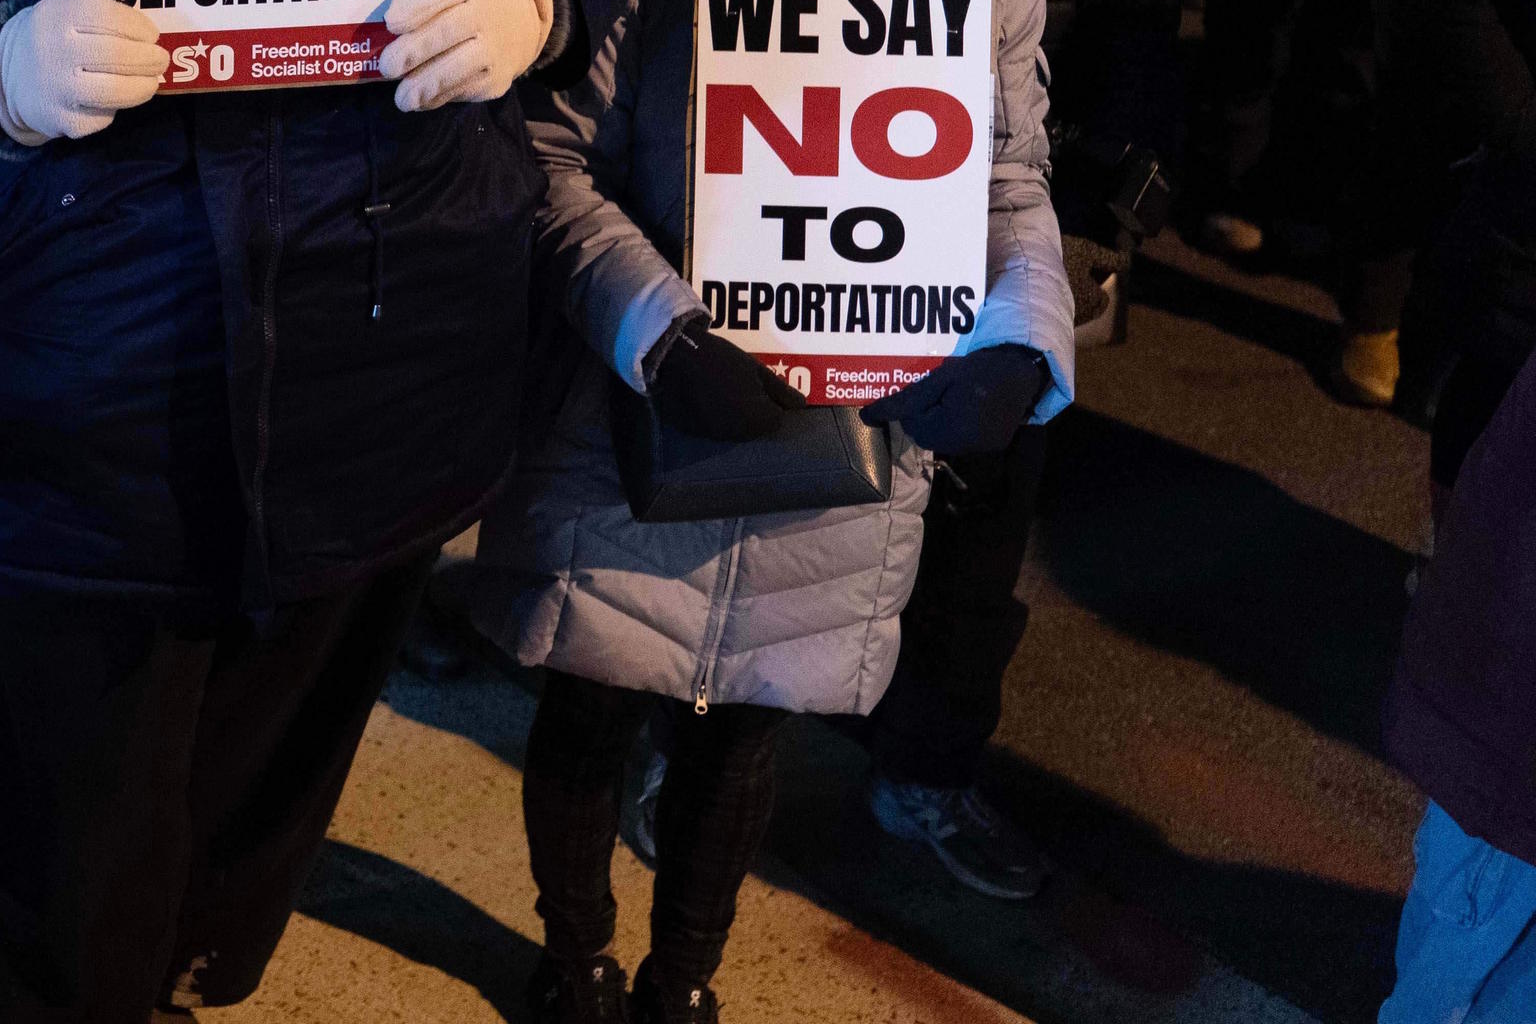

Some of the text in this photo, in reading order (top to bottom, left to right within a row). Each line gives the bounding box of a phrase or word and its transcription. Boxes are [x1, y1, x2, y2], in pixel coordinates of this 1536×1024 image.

[251, 42, 325, 60] Freedom
[329, 38, 370, 55] Road
[251, 56, 381, 78] Socialist Organi
[704, 83, 974, 180] NO
[761, 205, 905, 263] TO
[701, 280, 975, 334] DEPORTATIONS
[826, 368, 890, 383] Freedom
[825, 385, 886, 400] Socialist
